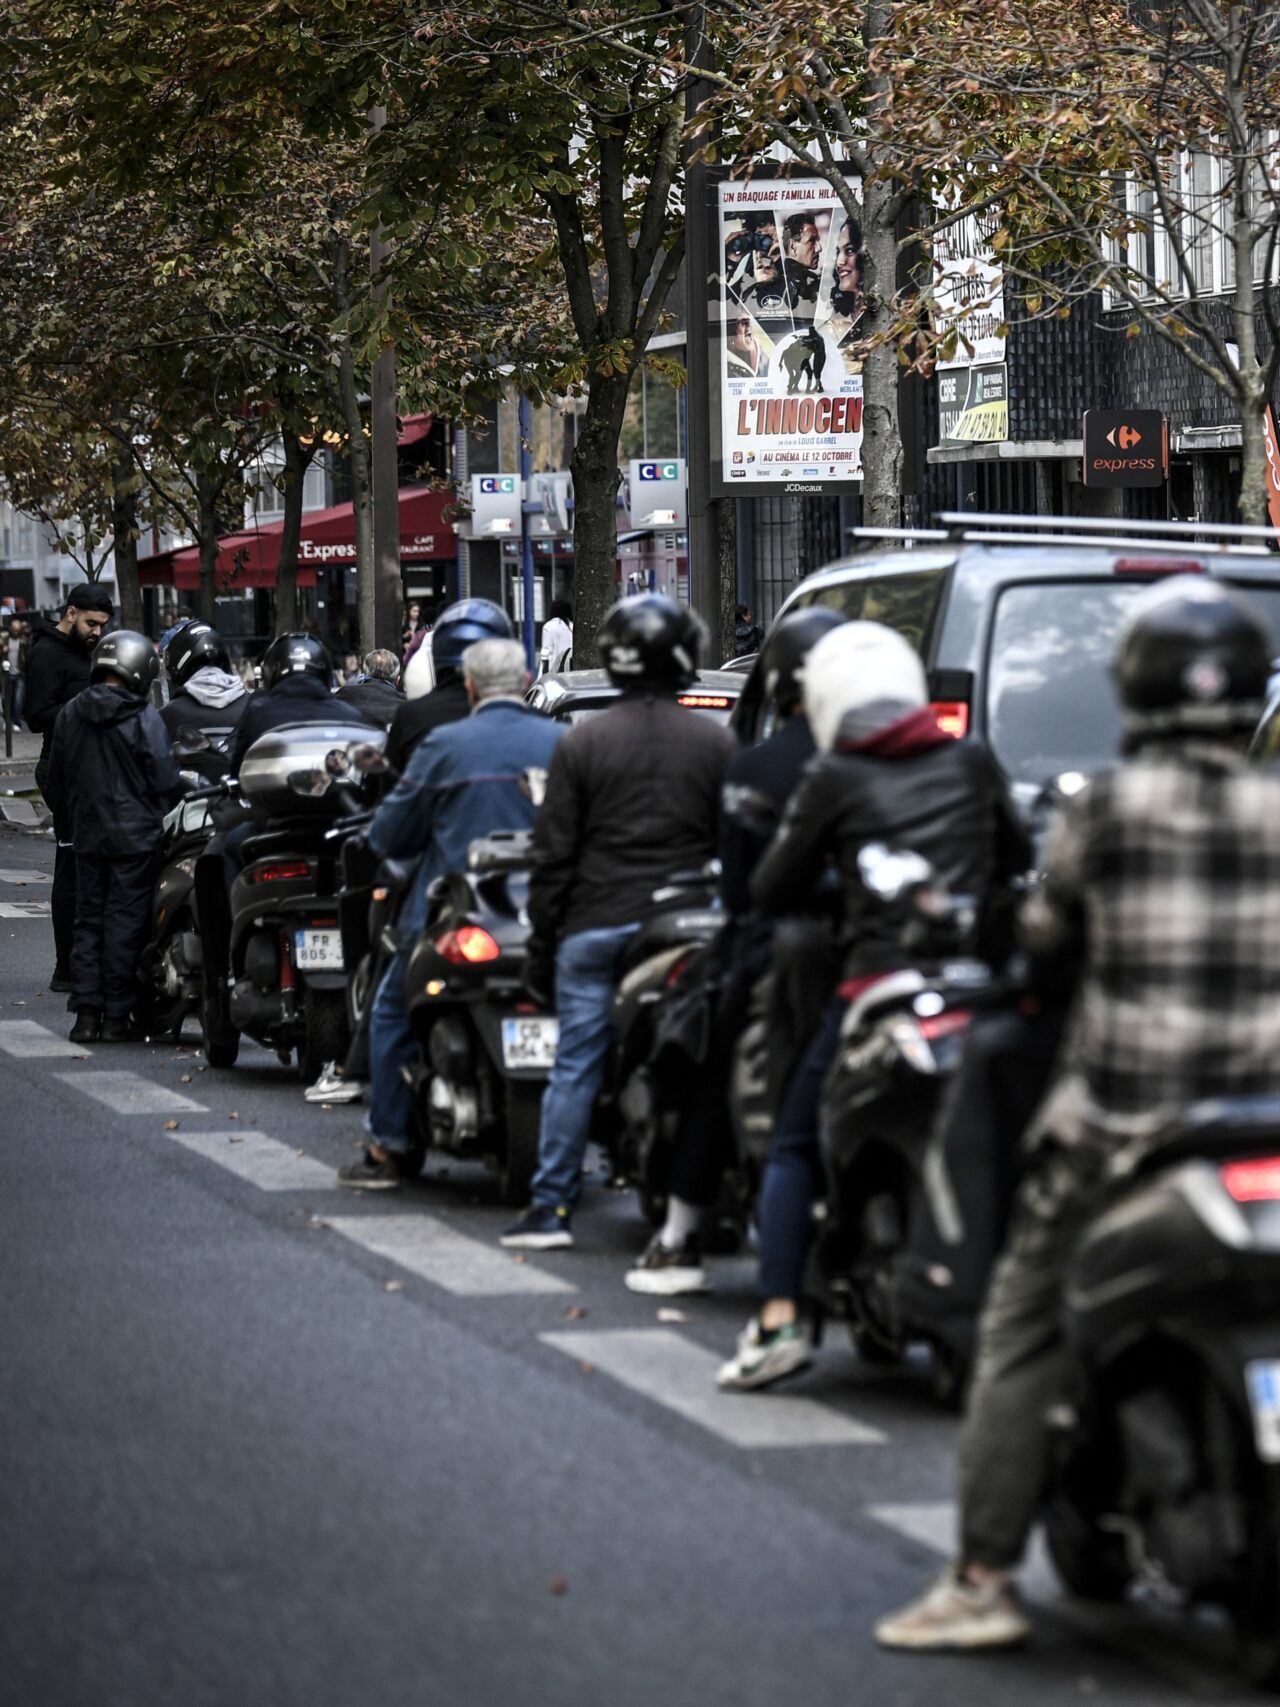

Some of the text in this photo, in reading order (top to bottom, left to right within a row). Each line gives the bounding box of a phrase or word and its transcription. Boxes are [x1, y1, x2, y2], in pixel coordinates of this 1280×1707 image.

[723, 193, 735, 203] UN
[737, 191, 778, 204] BRAQUAGE
[781, 189, 816, 201] FAMILIAL
[737, 396, 863, 436] L'INNOCEN
[798, 437, 815, 445] LOUIS
[816, 436, 837, 445] GARREL
[763, 451, 853, 462] AU CINÉMA LE 12 OCTOBRE
[640, 464, 676, 480] CIC
[1093, 457, 1155, 473] express
[481, 478, 513, 492] CIC
[784, 483, 823, 493] JCDecaux
[311, 935, 330, 947] FR
